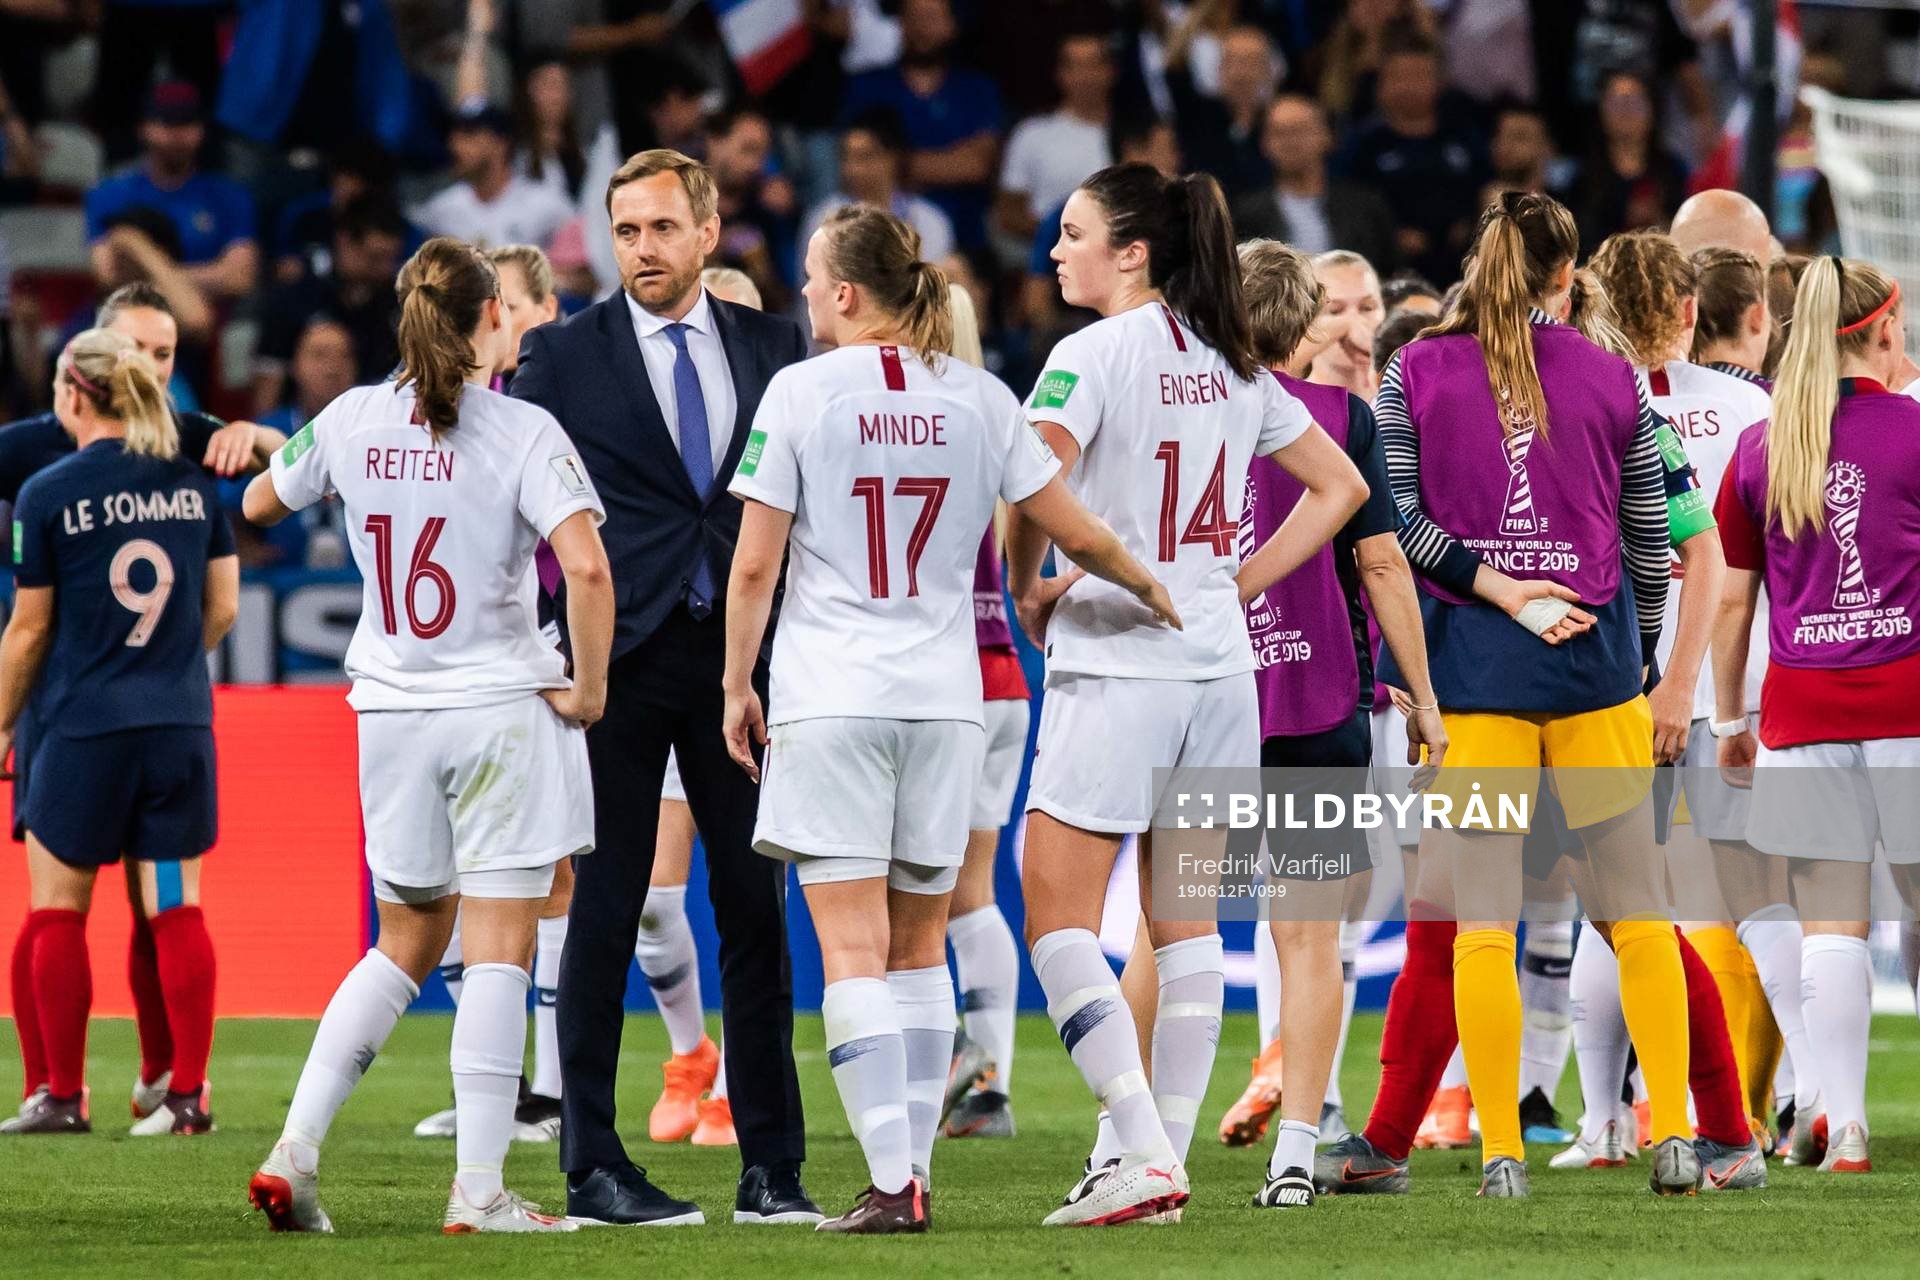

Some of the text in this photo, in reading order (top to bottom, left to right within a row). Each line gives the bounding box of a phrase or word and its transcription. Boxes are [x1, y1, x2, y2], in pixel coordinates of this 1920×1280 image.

[1160, 371, 1228, 405] ENGEN
[858, 414, 946, 445] MINDE
[1668, 410, 1720, 439] NES
[366, 448, 454, 482] REITEN
[63, 488, 206, 535] LE SOMMER
[1154, 438, 1239, 562] 14
[851, 477, 951, 599] 17
[1505, 518, 1533, 530] FIFA
[1462, 539, 1573, 551] WOMEN'S WORLD CUP
[1482, 550, 1580, 573] ANCE 2019
[365, 514, 456, 640] 16
[109, 538, 175, 647] 9
[1838, 591, 1866, 605] FIFA
[1793, 616, 1912, 645] FRANCE 2019
[1800, 606, 1905, 626] WOMEN'S WORLD CUP
[1275, 1187, 1310, 1206] NIKE
